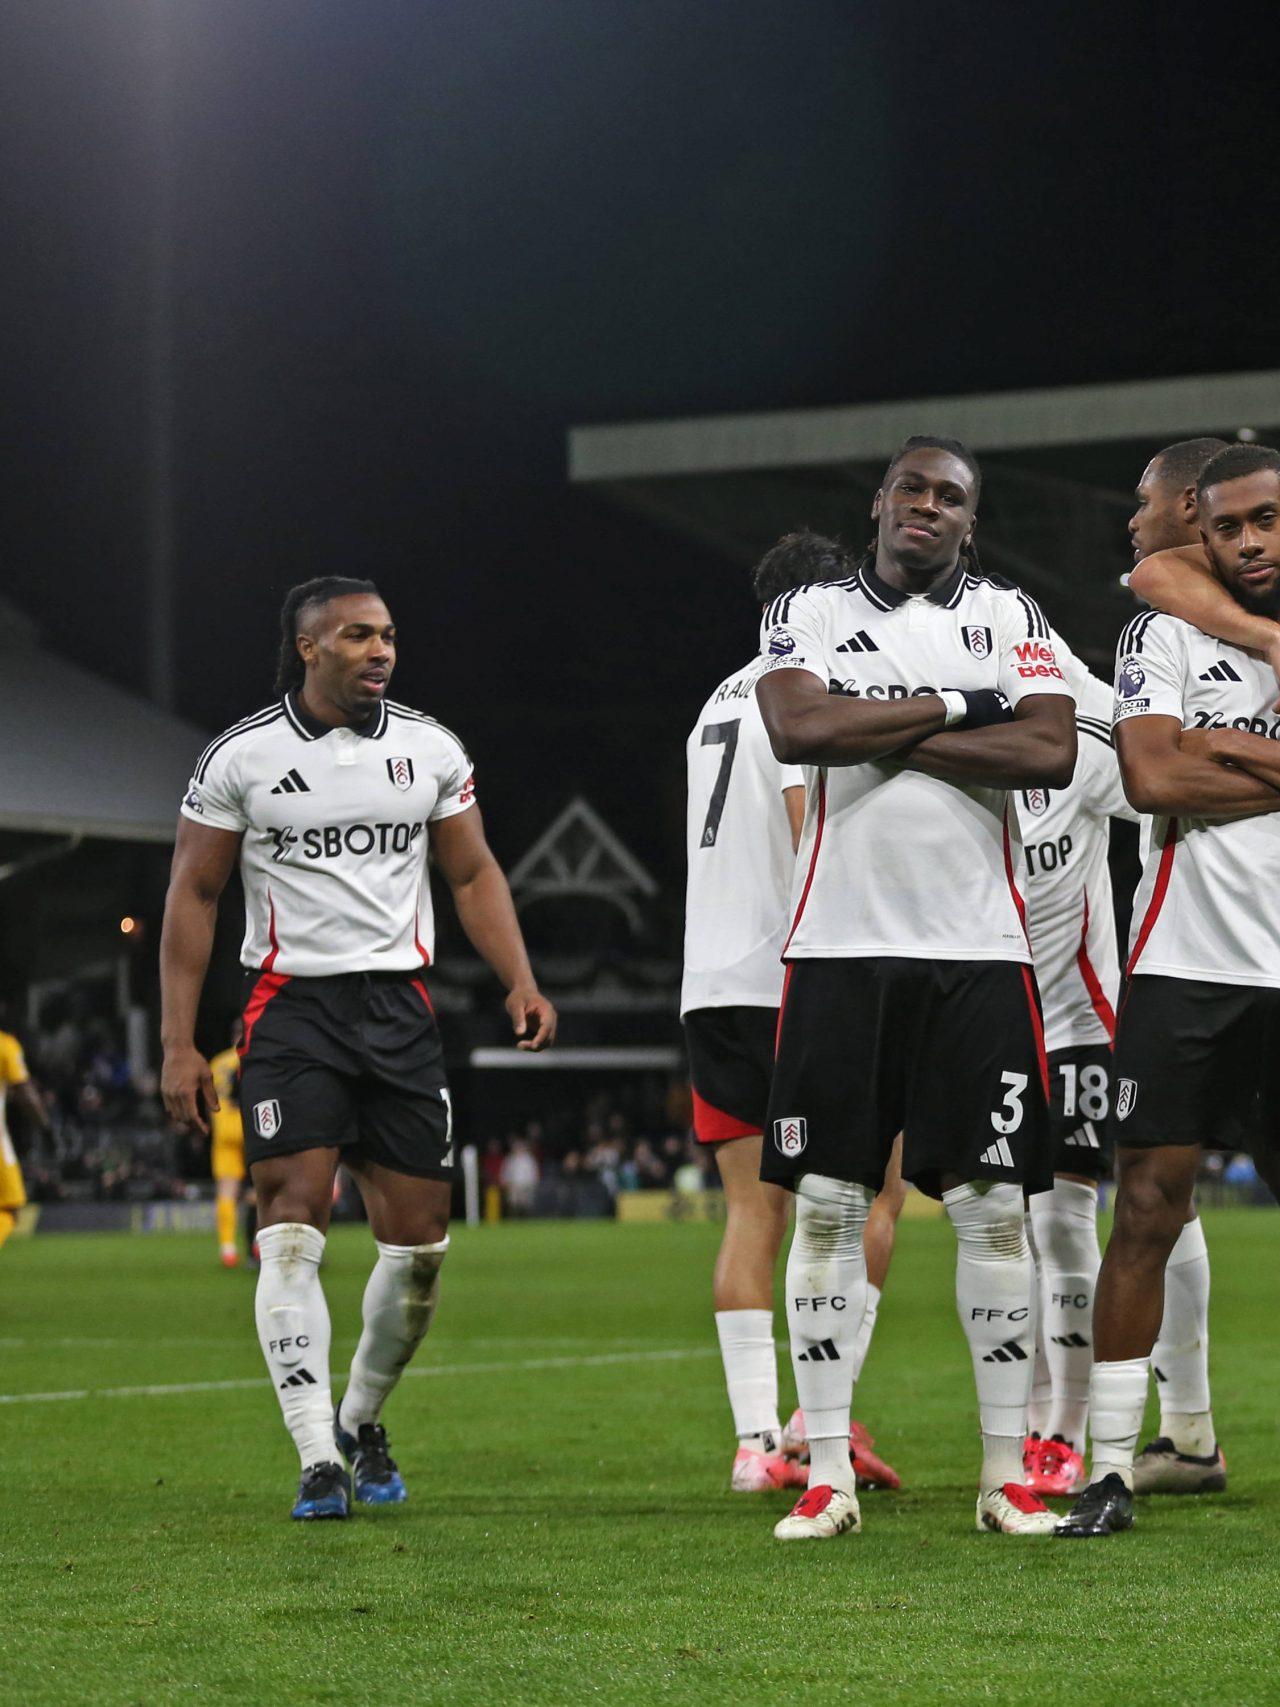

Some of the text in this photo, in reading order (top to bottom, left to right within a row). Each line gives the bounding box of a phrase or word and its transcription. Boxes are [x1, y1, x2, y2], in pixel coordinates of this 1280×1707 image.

[701, 718, 741, 848] 7
[1059, 1064, 1110, 1121] 18
[990, 1070, 1029, 1134] 3
[795, 1296, 847, 1311] FFC
[1052, 1294, 1088, 1309] FFC
[971, 1307, 1029, 1322] FFC
[269, 1335, 309, 1353] FFC
